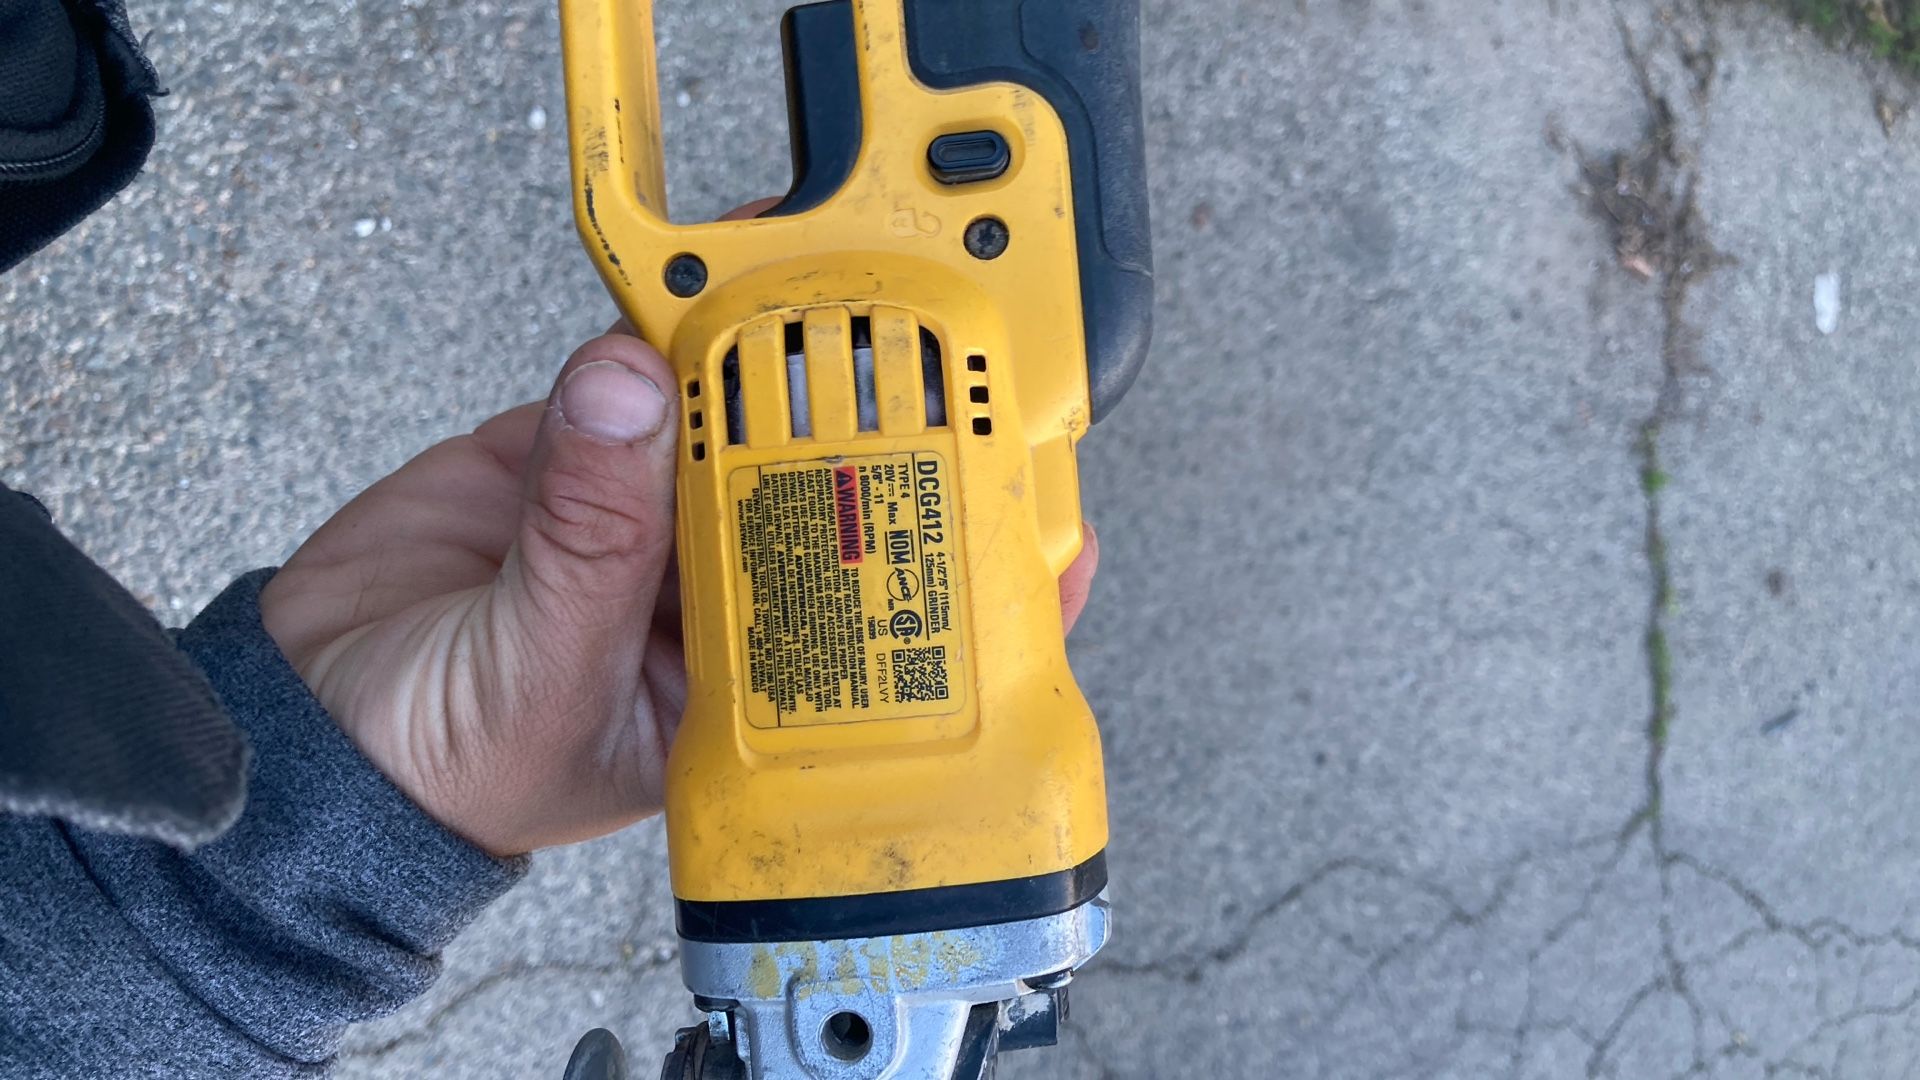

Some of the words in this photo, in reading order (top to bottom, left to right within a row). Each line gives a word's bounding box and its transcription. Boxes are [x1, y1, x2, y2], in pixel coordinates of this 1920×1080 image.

[761, 474, 770, 490] LIRE
[796, 471, 806, 502] ALWAYS
[806, 470, 815, 493] LEAST
[824, 468, 833, 501] ALWAYS
[871, 465, 883, 484] 5/8"
[898, 462, 910, 490] TYPE
[762, 493, 771, 501] LE
[770, 473, 780, 511] BATERIAS
[779, 473, 788, 504] SEGURO
[788, 472, 798, 503] DEWALT
[815, 469, 826, 521] RESPIRATORY
[860, 475, 872, 519] 8000/min
[874, 493, 884, 504] 11
[745, 498, 753, 513] FOR
[752, 488, 762, 520] DEWALT
[782, 506, 790, 520] LEA
[800, 504, 808, 519] USE
[808, 496, 817, 521] EQUAL
[827, 502, 835, 526] WEAR
[887, 502, 898, 525] Max
[917, 461, 943, 544] DCG412
[746, 515, 755, 547] SERVICE
[774, 513, 783, 547] DEWALT.
[783, 522, 791, 531] EL
[801, 521, 810, 550] PROPER
[810, 523, 818, 533] TO
[829, 528, 837, 542] EYE
[836, 487, 860, 560] WARNING
[754, 522, 765, 569] INDUSTRIAL
[766, 531, 776, 565] UTILISER
[784, 532, 794, 567] MANUAL
[811, 535, 820, 550] THE
[819, 524, 830, 574] PROTECTION.
[862, 522, 876, 554] (RPM)
[889, 530, 910, 564] NOM
[787, 569, 795, 579] DE
[803, 552, 813, 583] GUARDS
[813, 552, 823, 593] MAXIMUM
[830, 544, 841, 595] PROTECTION.
[841, 568, 851, 591] MUST
[850, 567, 858, 577] TO
[925, 553, 937, 587] 125mm)
[759, 570, 767, 591] TOOL
[768, 567, 780, 613] SEULEMENT
[824, 576, 832, 592] USE
[895, 567, 913, 602] ANCE
[806, 585, 815, 609] WHEN
[825, 593, 834, 613] ONLY
[843, 593, 852, 614] READ
[851, 579, 861, 609] REDUCE
[816, 595, 825, 620] SPEED
[834, 597, 844, 629] ALWAYS
[854, 610, 862, 625] THE
[928, 590, 940, 633] GRINDER
[938, 592, 951, 630] (115mm/
[772, 615, 782, 635] AVEC
[855, 627, 864, 644] RISK
[877, 619, 888, 636] US
[747, 626, 756, 650] MADE
[774, 637, 783, 653] DES
[801, 633, 810, 655] PARA
[818, 622, 828, 656] MARKED
[827, 615, 838, 669] ACCESSORIES
[837, 631, 846, 646] USE
[845, 616, 857, 669] INSTRUCTION
[749, 651, 757, 660] IN
[764, 648, 773, 661] MD
[784, 647, 793, 669] TITRE
[793, 648, 803, 677] UTILICE
[803, 656, 810, 666] EL
[811, 653, 820, 668] USE
[857, 646, 865, 655] OF
[776, 654, 785, 676] PILES
[821, 658, 829, 670] ON
[838, 648, 848, 679] PROPER
[750, 662, 759, 693] MEXICO
[795, 679, 804, 694] LAS
[804, 667, 813, 702] MANEJO
[813, 670, 821, 689] ONLY
[822, 671, 830, 687] THE
[831, 671, 840, 696] RATED
[876, 653, 889, 703] DFF2LVY
[767, 685, 776, 702] USA
[778, 678, 787, 713] DEWALT.
[814, 691, 823, 712] WITH
[833, 698, 841, 708] AT
[860, 688, 869, 708] USER
